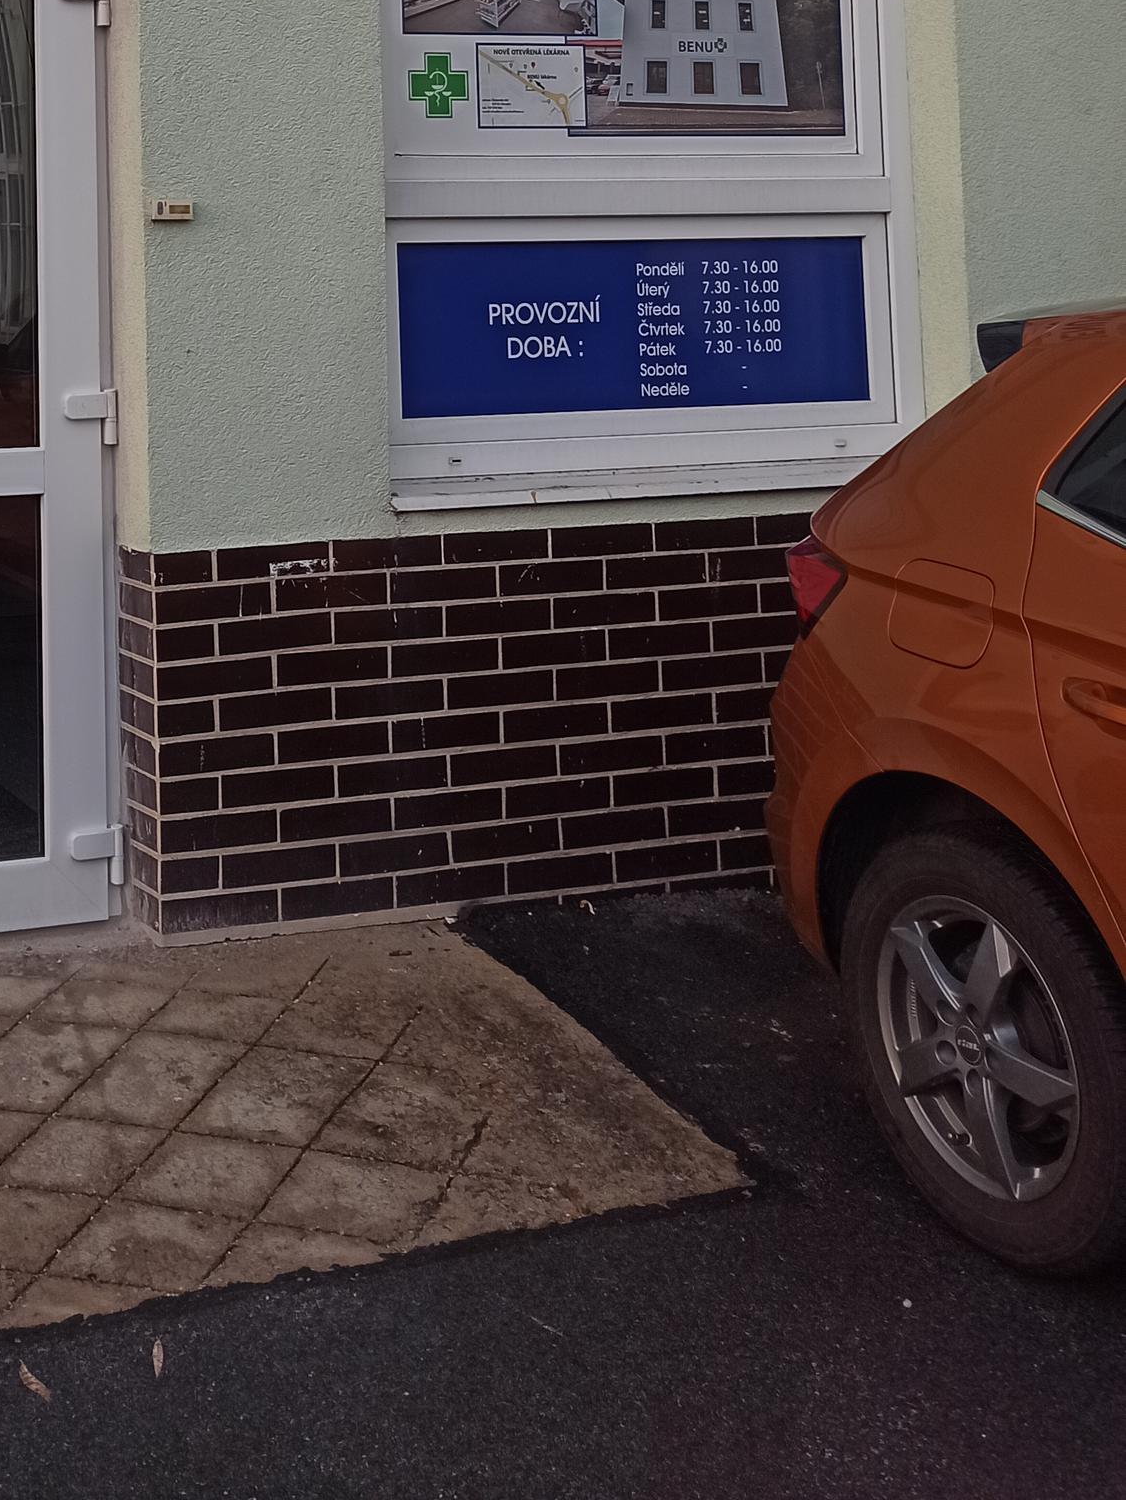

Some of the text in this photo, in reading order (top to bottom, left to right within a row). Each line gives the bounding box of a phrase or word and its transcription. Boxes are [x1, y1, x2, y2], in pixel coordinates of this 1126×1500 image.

[679, 41, 713, 52] BENU
[637, 262, 684, 276] Pondělí
[702, 261, 729, 274] 7.30
[743, 260, 778, 273] 16.00
[637, 280, 669, 298] Úterý
[703, 281, 730, 294] 7.30
[744, 280, 778, 293] 16.00
[489, 295, 600, 325] PROVOZNÍ
[638, 302, 680, 316] Středa
[703, 300, 731, 314] 7.30
[745, 300, 779, 312] 16.00
[639, 319, 685, 336] Čtvrtek
[704, 320, 732, 333] 7.30
[746, 319, 780, 332] 16.00
[508, 336, 571, 358] DOBA
[640, 342, 676, 356] Pátek
[705, 340, 732, 353] 7.30
[746, 339, 781, 352] 16.00
[640, 363, 687, 376] Sobota
[641, 382, 689, 396] Neděle
